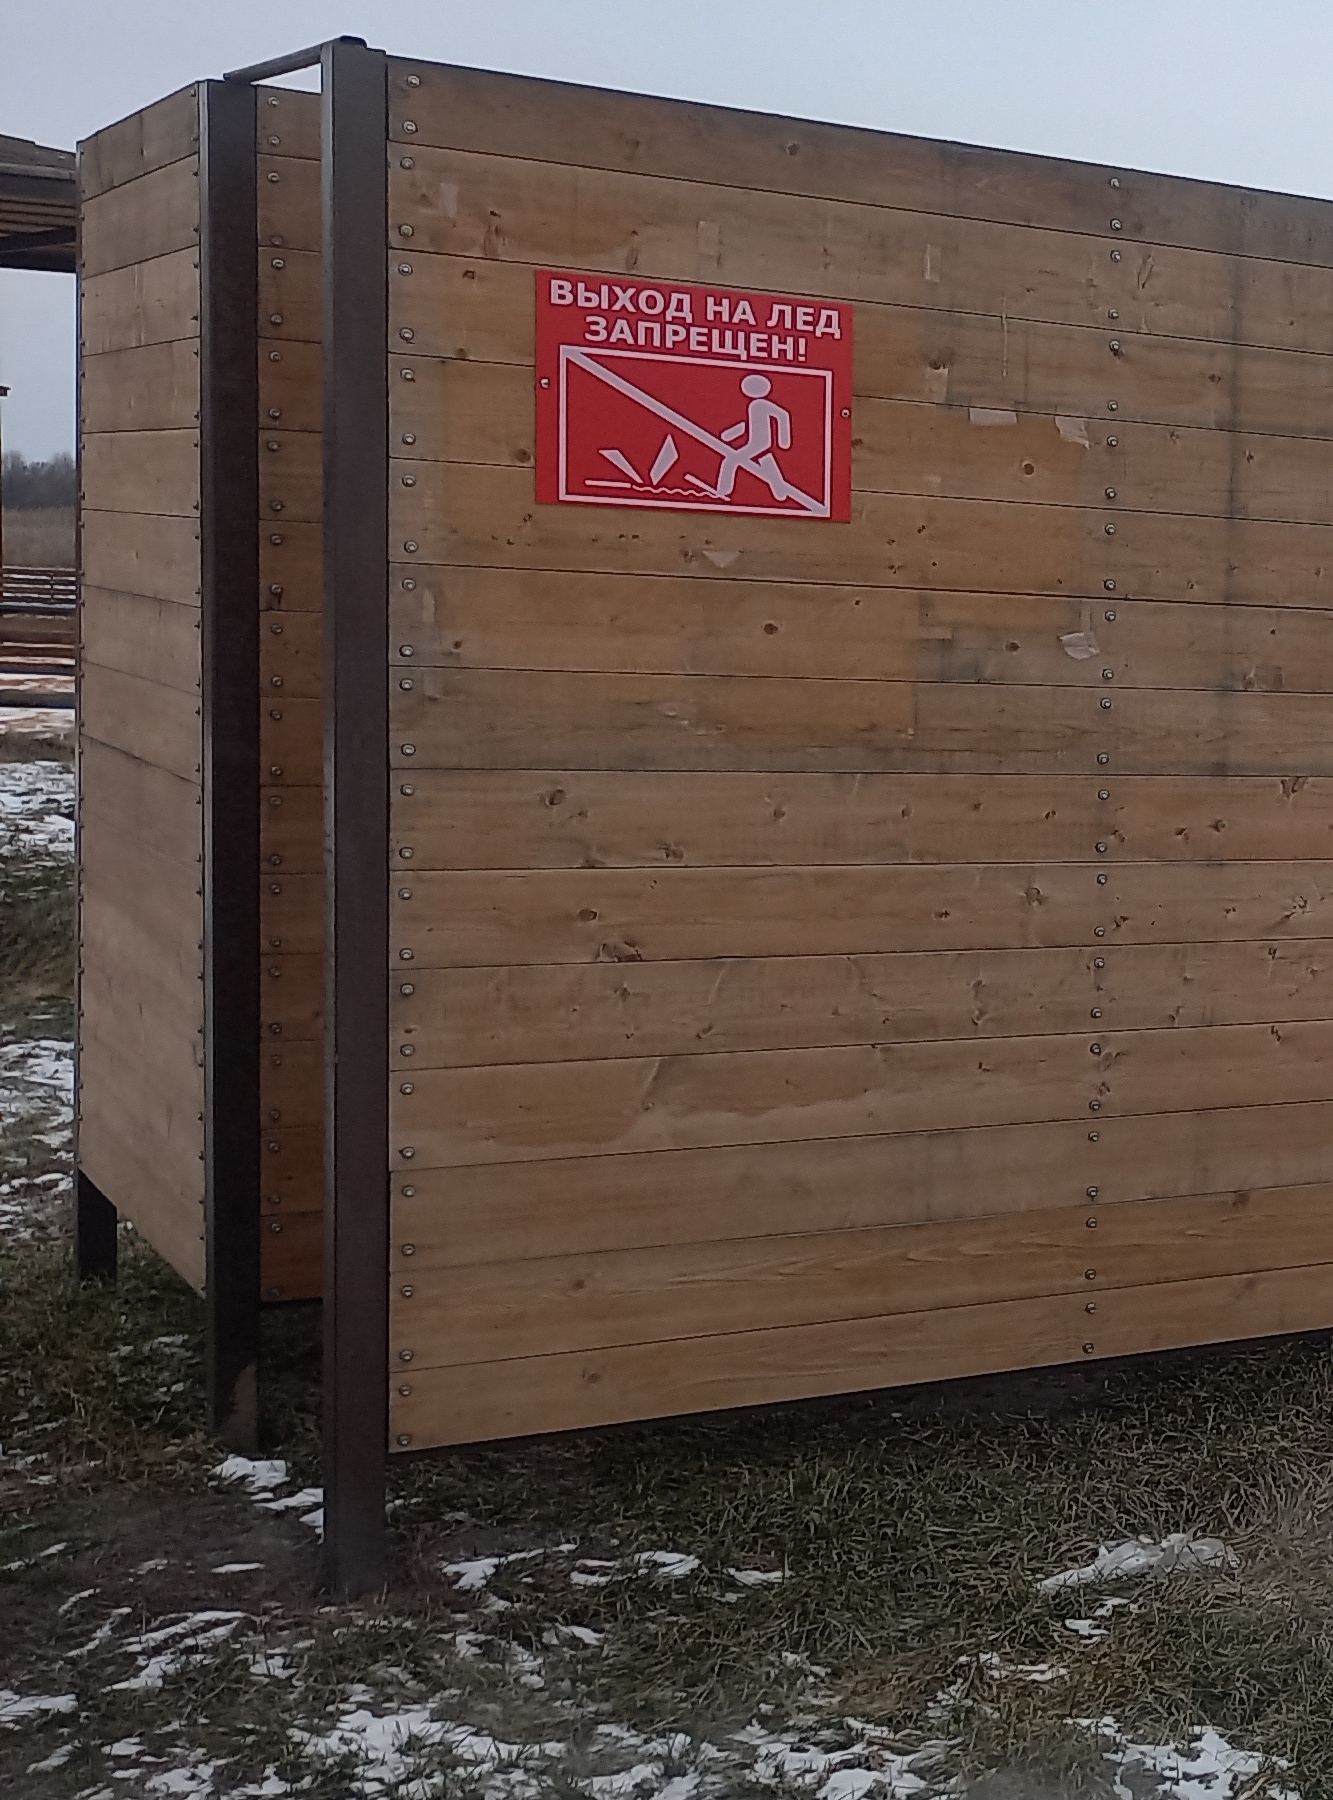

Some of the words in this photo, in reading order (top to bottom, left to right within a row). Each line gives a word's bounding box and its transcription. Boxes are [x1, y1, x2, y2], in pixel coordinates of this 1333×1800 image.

[550, 279, 693, 324] ВЫХОД
[706, 296, 756, 326] НА
[766, 303, 842, 340] ЛЕД
[584, 315, 808, 362] ЗАПРЕЩЕН!
